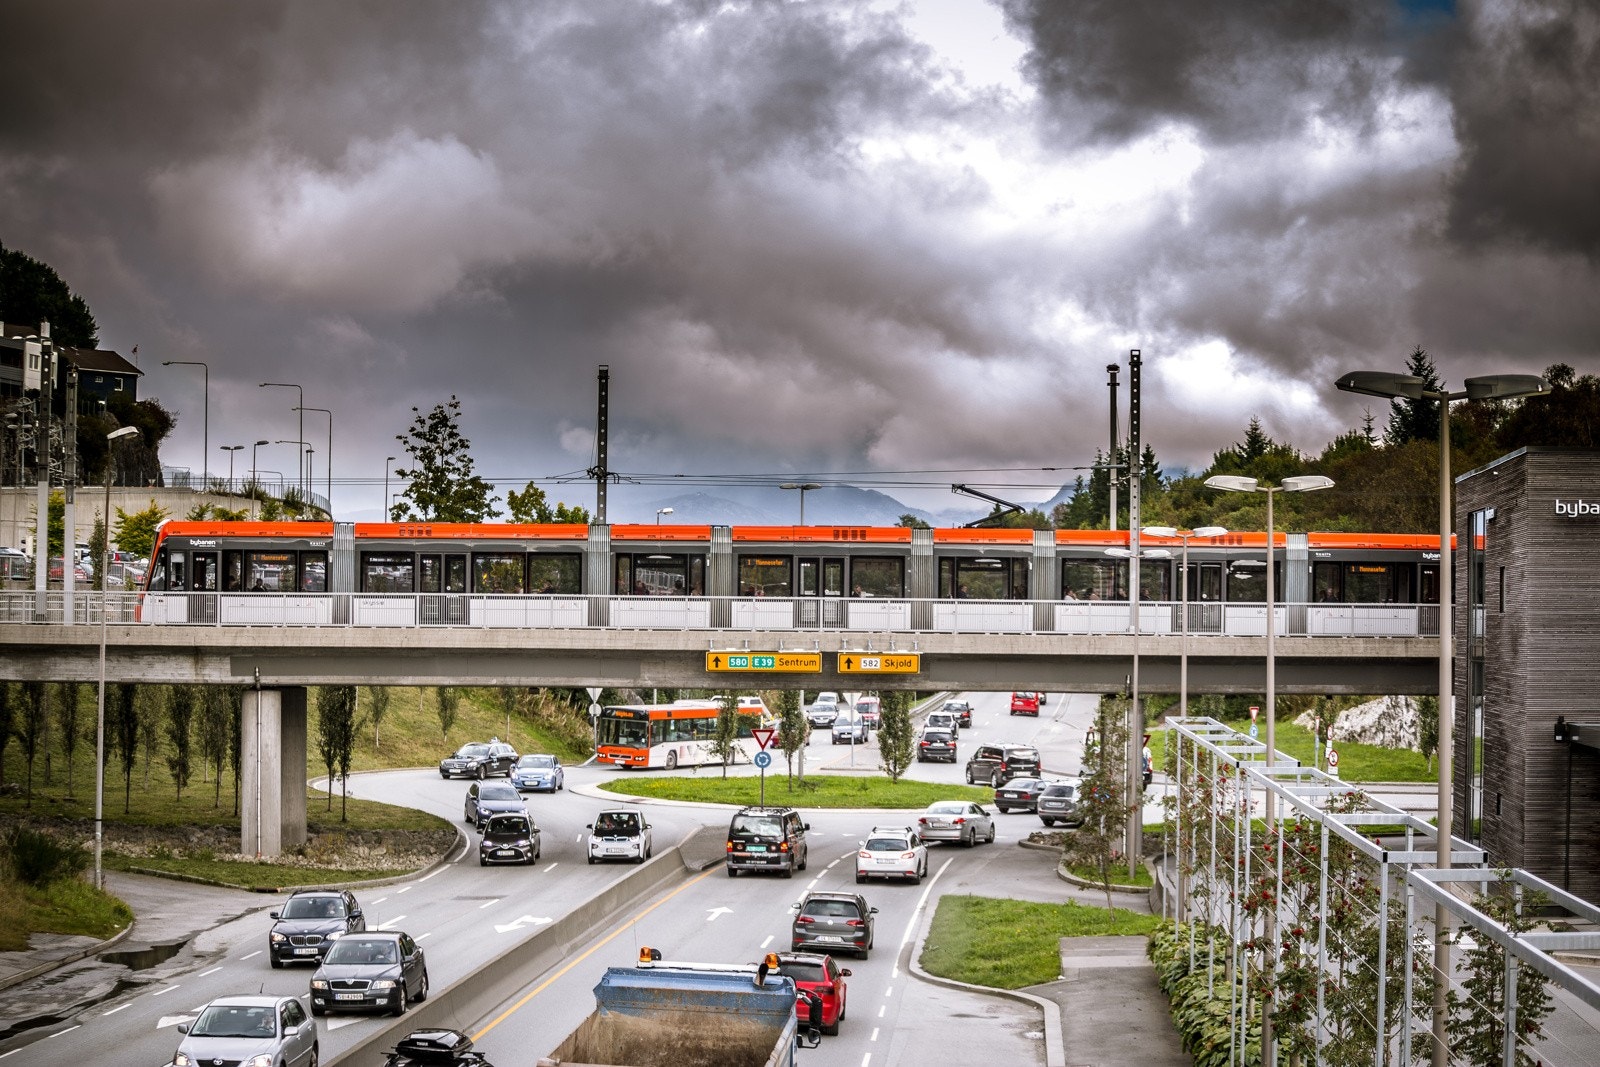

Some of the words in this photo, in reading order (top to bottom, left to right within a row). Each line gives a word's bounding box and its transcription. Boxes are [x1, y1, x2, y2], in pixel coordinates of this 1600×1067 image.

[190, 538, 216, 546] bybanen
[730, 658, 747, 667] 580
[754, 658, 760, 666] E
[761, 658, 772, 667] 39
[778, 658, 817, 667] Sentrum
[862, 659, 879, 668] 582
[884, 658, 912, 669] Skjold
